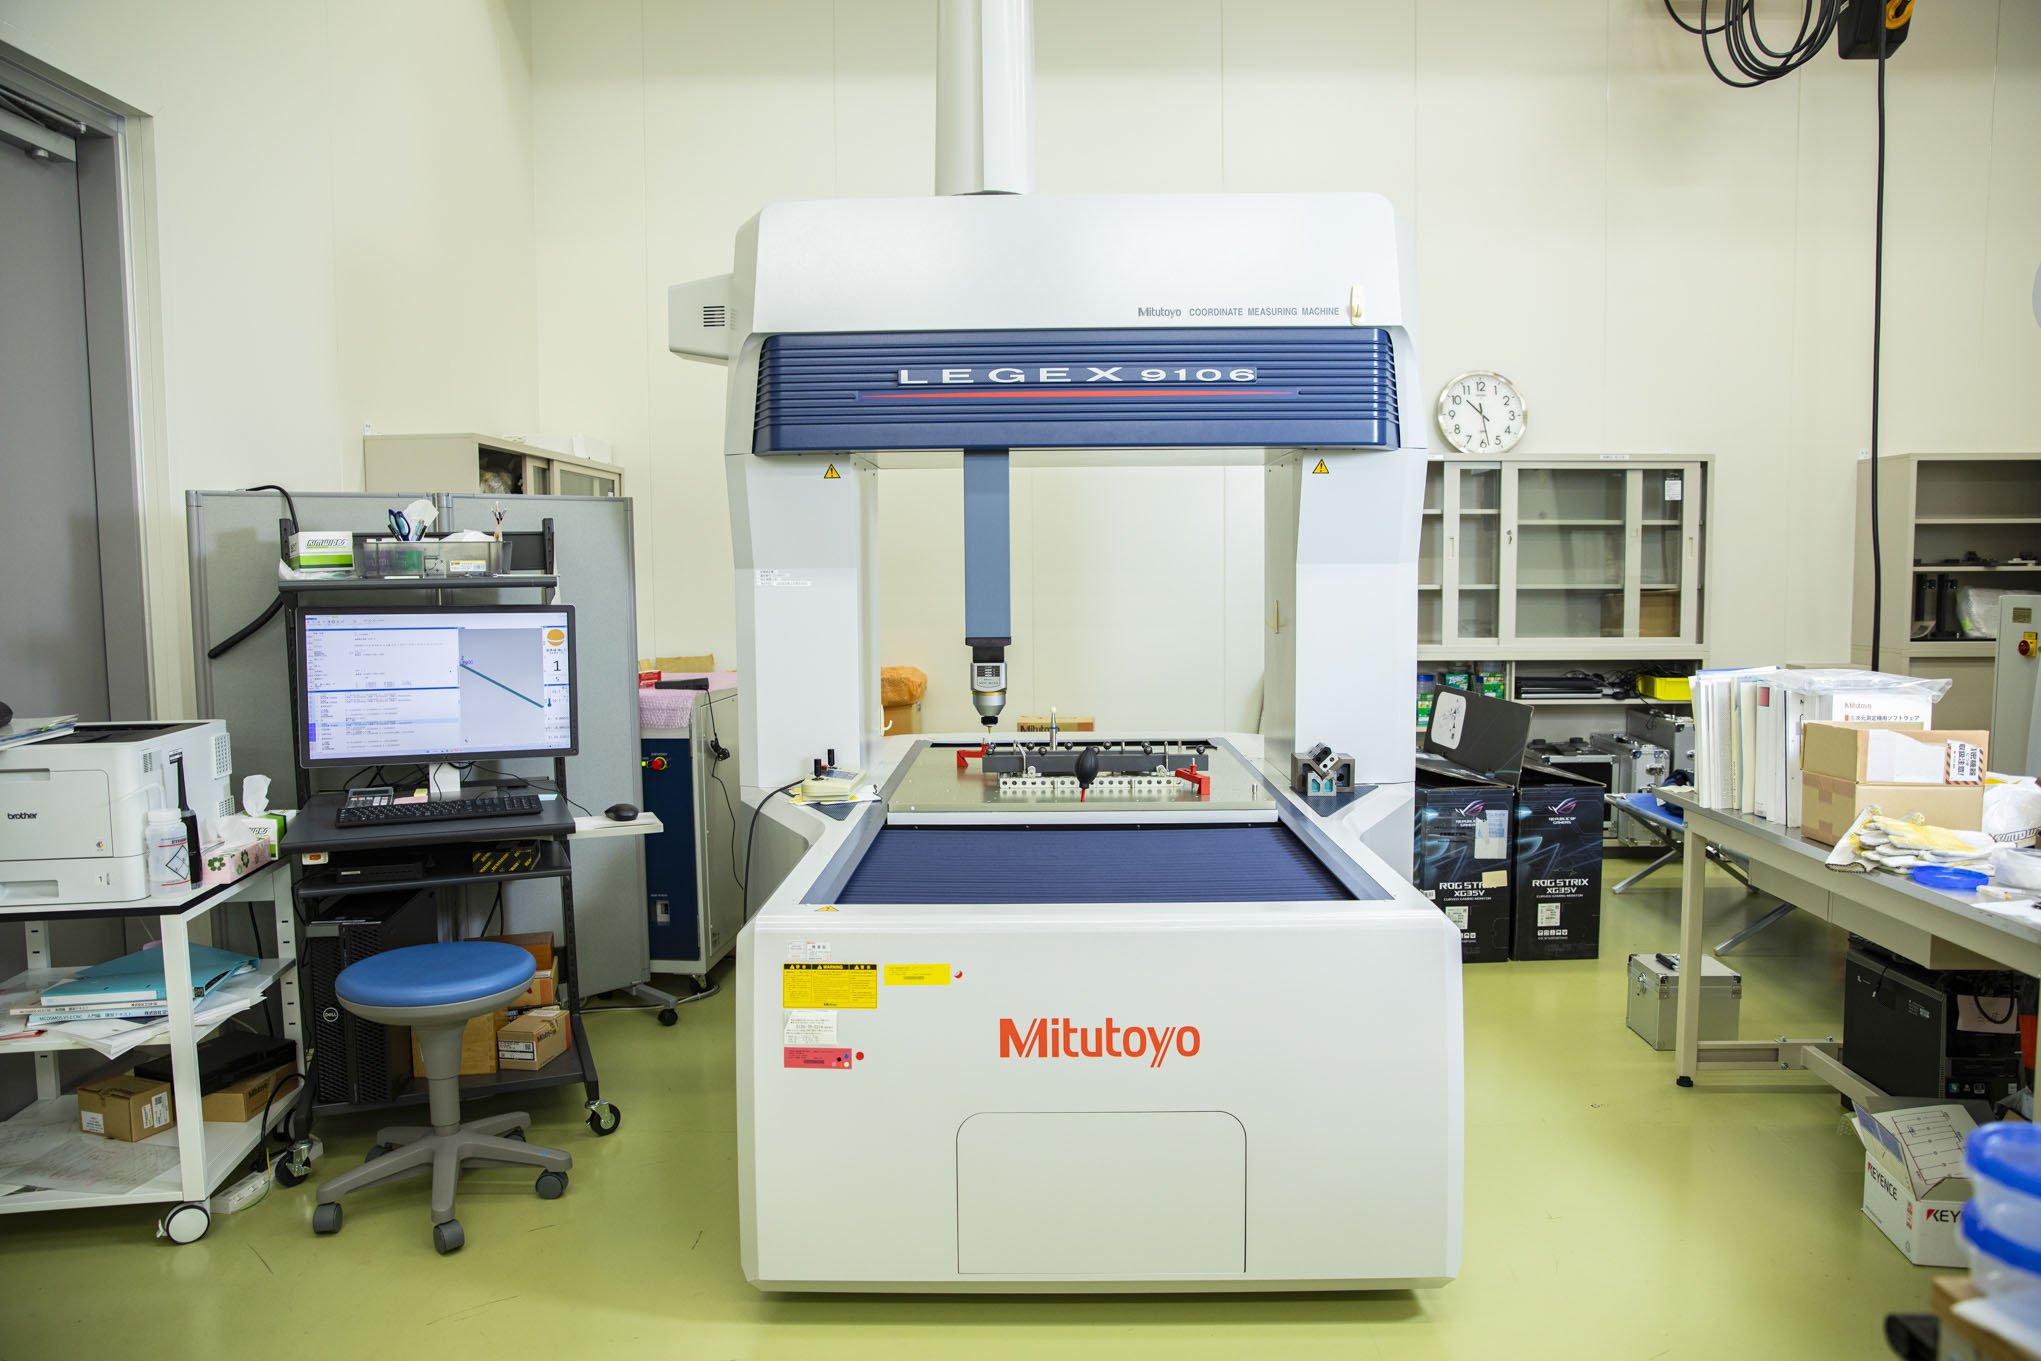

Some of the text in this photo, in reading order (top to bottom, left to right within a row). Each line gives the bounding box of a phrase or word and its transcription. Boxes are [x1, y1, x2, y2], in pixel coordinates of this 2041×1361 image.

[1138, 306, 1340, 319] Mitutoyo COORDINATE MEASURING MACHINE
[900, 366, 1256, 384] LEGEX 9106
[1463, 385, 1471, 395] 11
[1475, 381, 1486, 392] 12
[1494, 385, 1498, 396] 1
[1451, 395, 1462, 406] 10
[1502, 395, 1511, 406] 2
[1448, 410, 1456, 420] 9
[1508, 410, 1516, 421] 3
[1453, 424, 1462, 435] 8
[1504, 425, 1512, 434] 4
[1466, 435, 1473, 445] 7
[1479, 439, 1488, 448] 6
[1495, 436, 1502, 446] 5
[553, 660, 561, 672] 1
[7, 812, 38, 820] brother
[1439, 882, 1462, 890] ROG
[1532, 878, 1589, 887] ROG STRIX
[1000, 1018, 1200, 1068] Mitutoyo
[1867, 1161, 1898, 1201] KEYENCE
